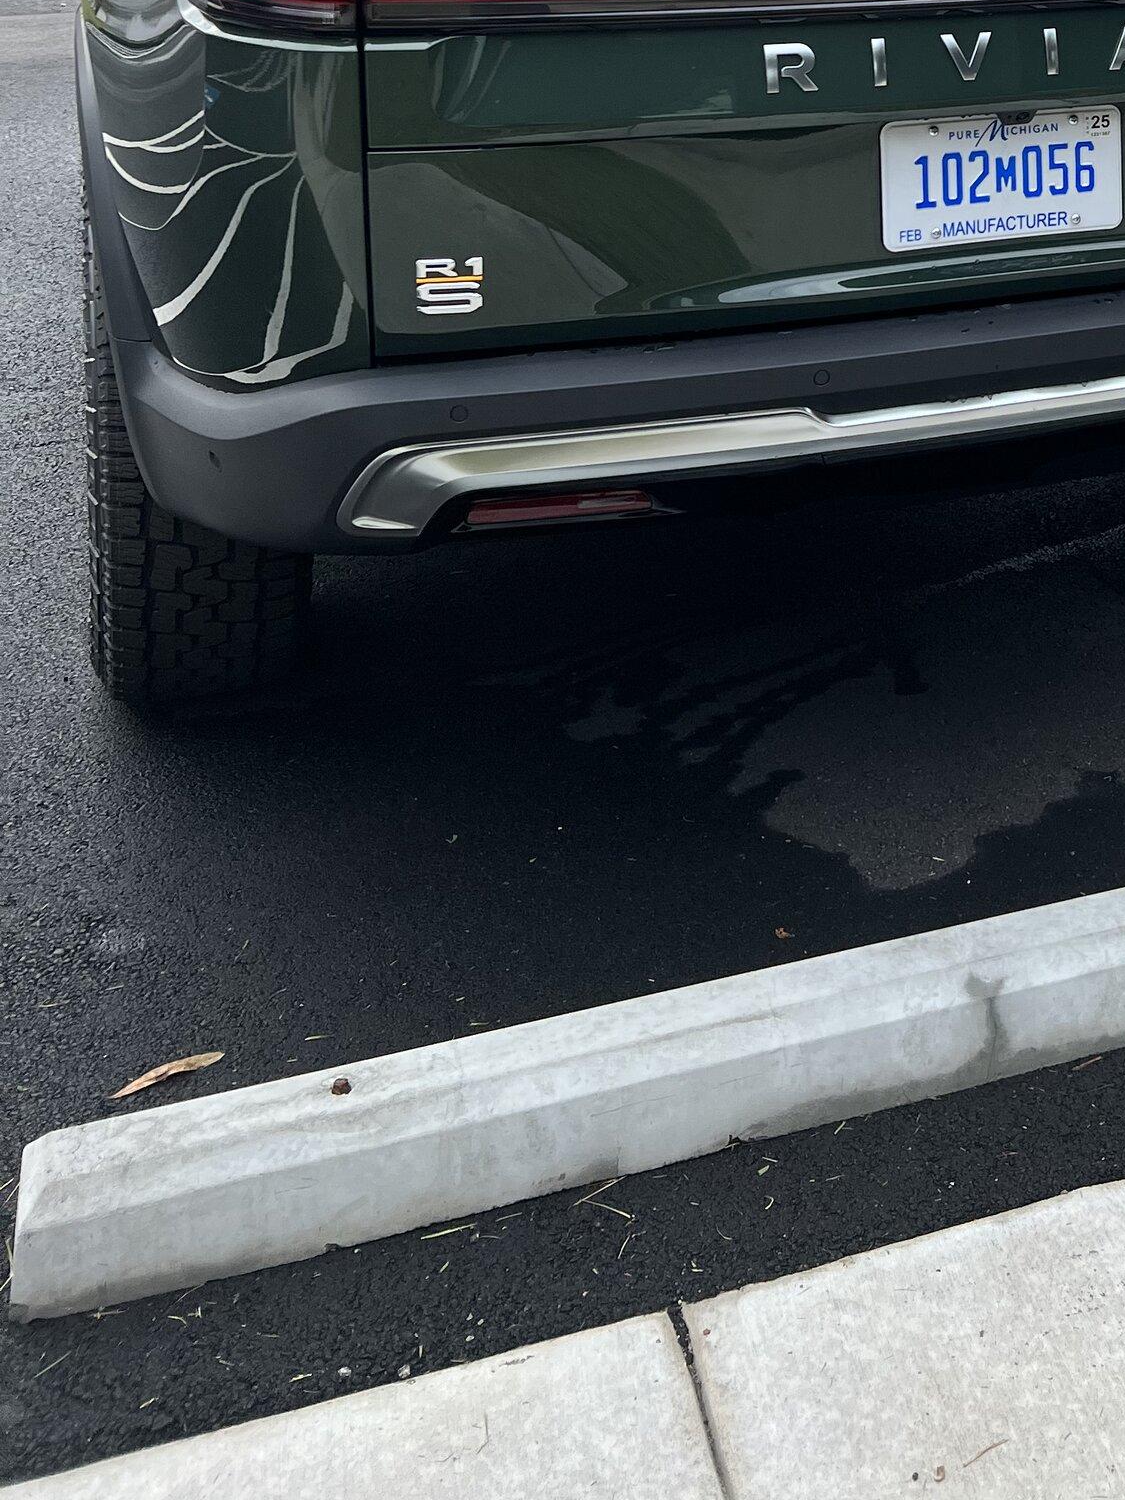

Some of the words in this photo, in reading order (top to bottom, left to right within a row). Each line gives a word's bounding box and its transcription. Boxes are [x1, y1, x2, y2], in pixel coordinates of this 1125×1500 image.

[1091, 114, 1110, 129] 25
[948, 129, 980, 141] PURE
[914, 140, 1095, 209] 102M056
[899, 228, 922, 242] FEB
[942, 211, 1068, 238] MANUFACTURER
